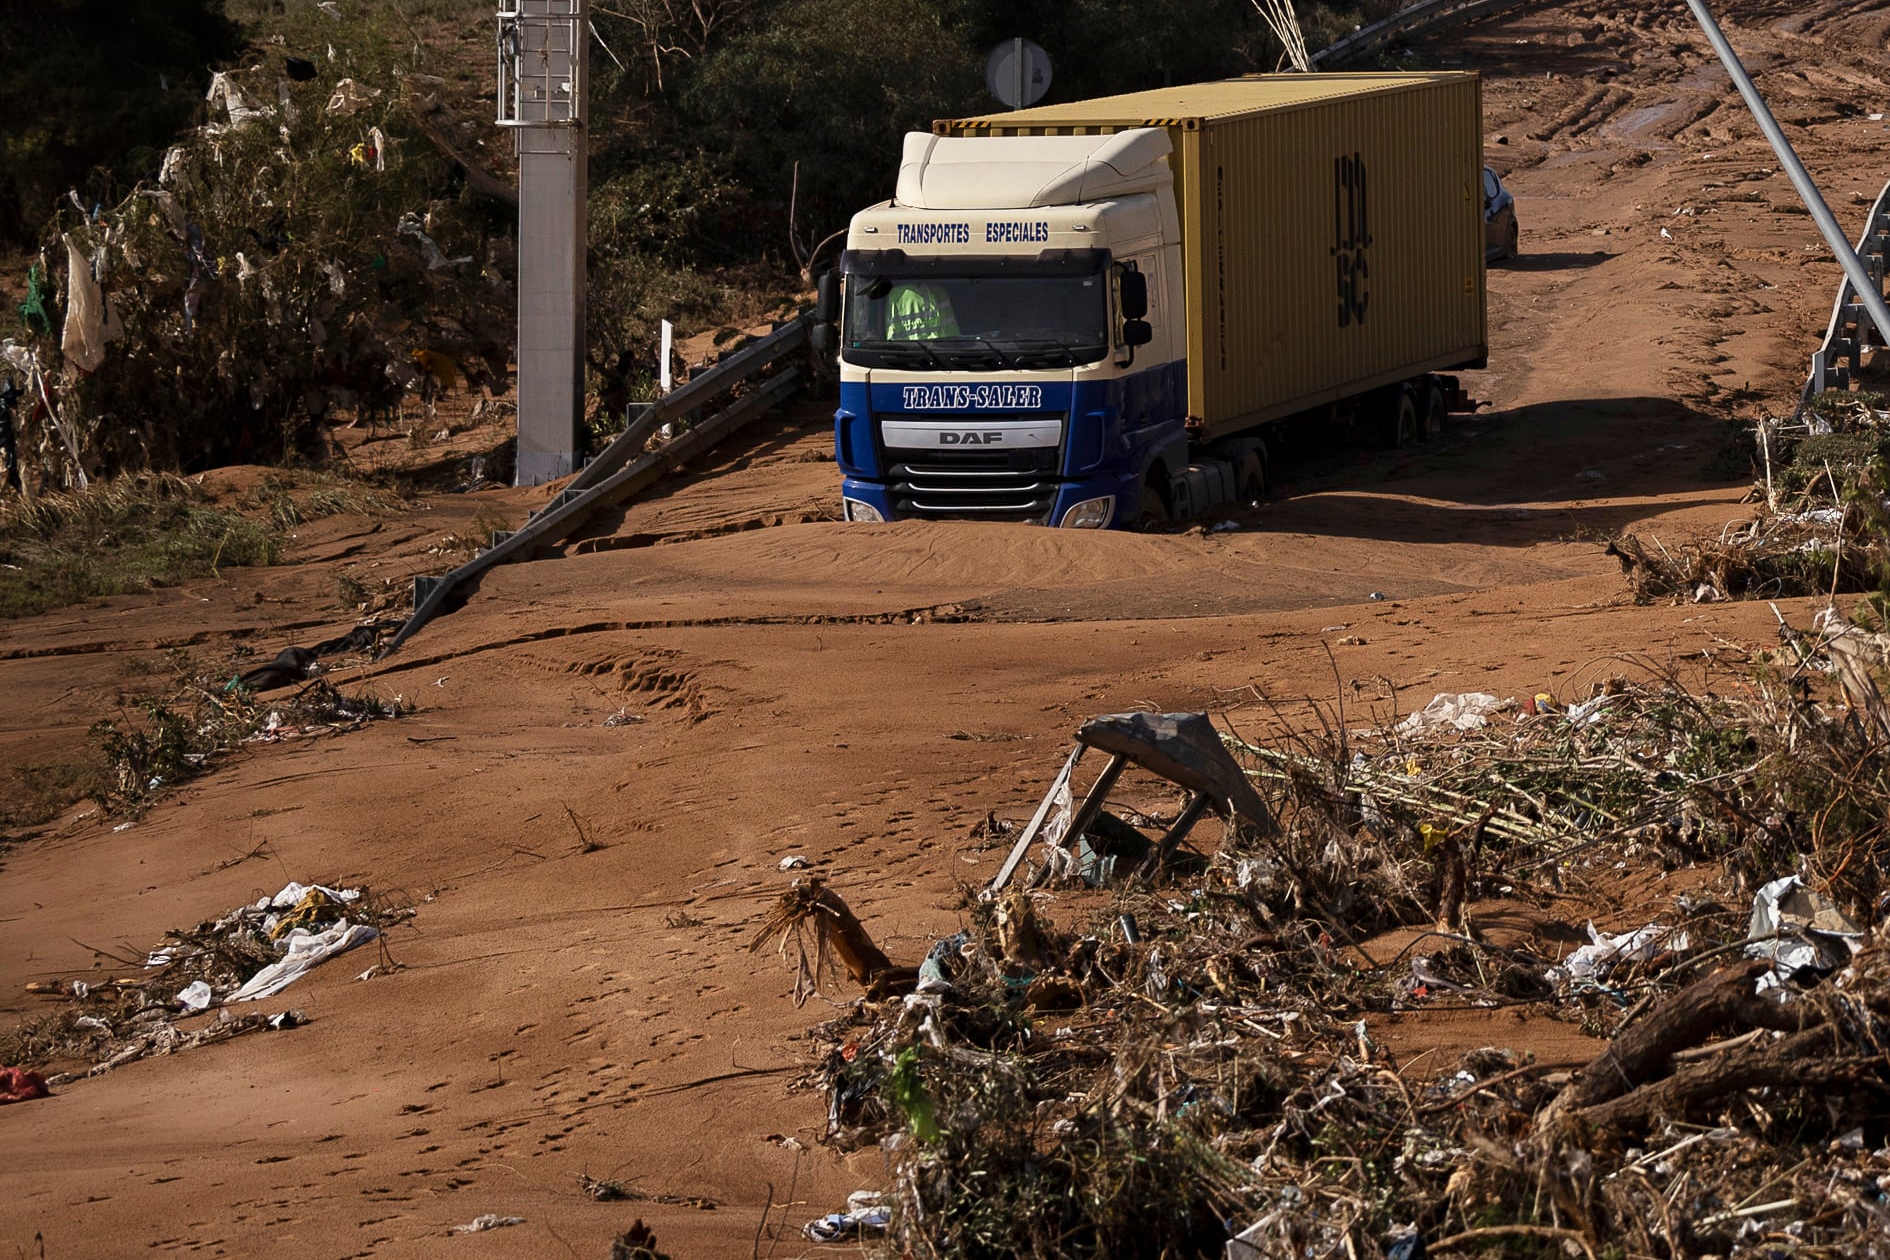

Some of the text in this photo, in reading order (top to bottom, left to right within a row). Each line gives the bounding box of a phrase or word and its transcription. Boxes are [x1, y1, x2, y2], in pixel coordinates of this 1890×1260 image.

[897, 221, 1049, 244] TRANSPORTES ESPECIALES
[903, 385, 1042, 409] TRANS-SALER
[939, 432, 1003, 445] DAF
